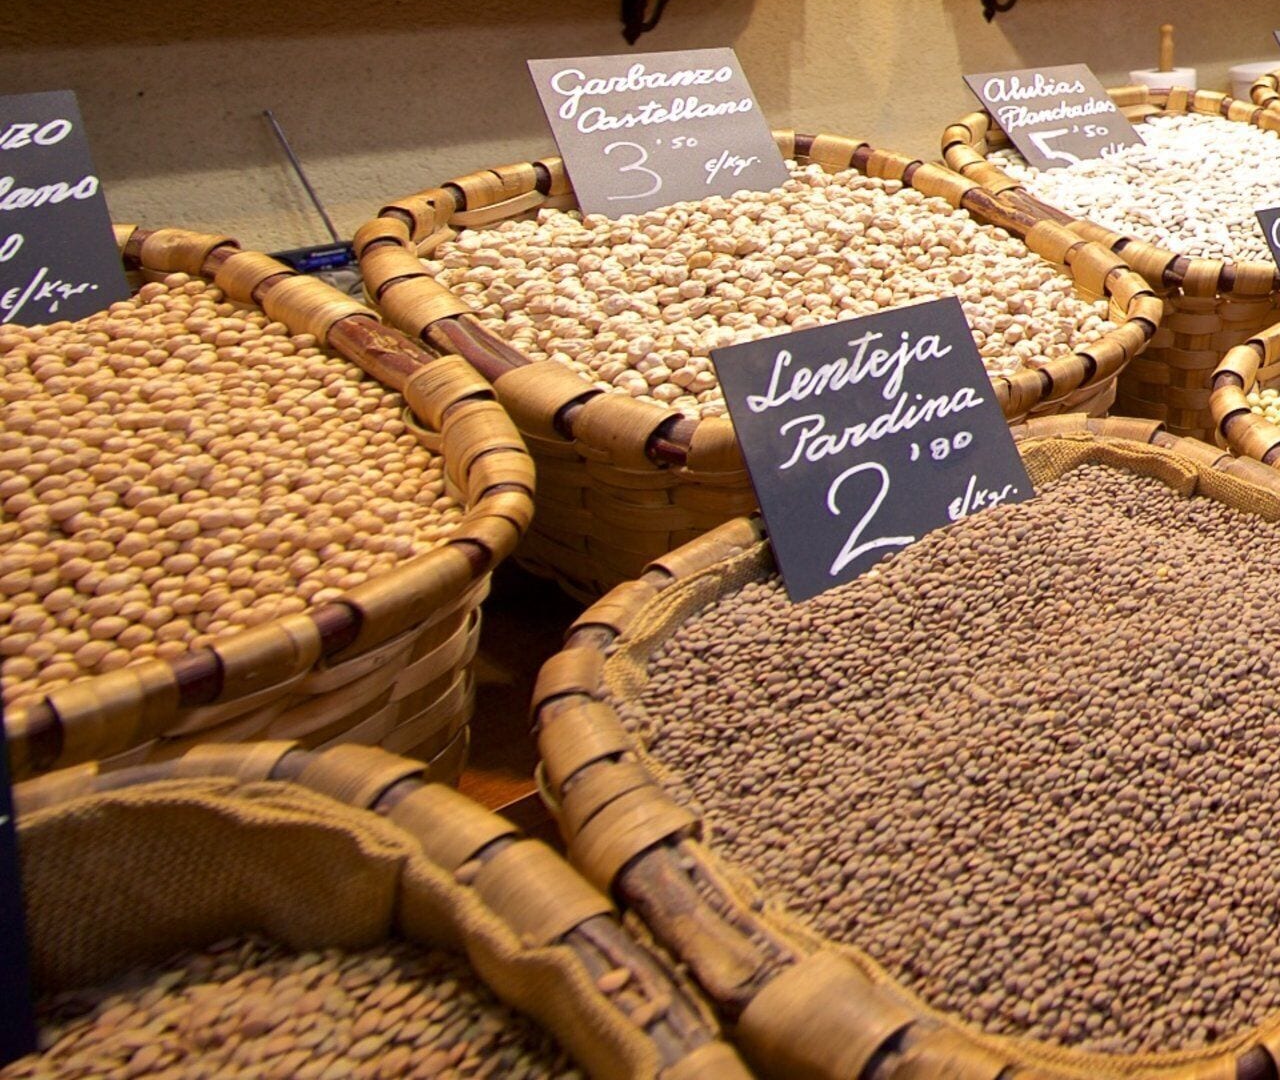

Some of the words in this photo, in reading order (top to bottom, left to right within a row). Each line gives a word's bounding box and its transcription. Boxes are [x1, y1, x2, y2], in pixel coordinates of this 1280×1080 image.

[551, 63, 734, 120] Garbanzo
[984, 73, 1086, 103] Alubias
[577, 95, 754, 134] Castellano
[997, 97, 1117, 134] Planchadas
[746, 331, 953, 413] Lenteja
[779, 387, 985, 470] Pardina
